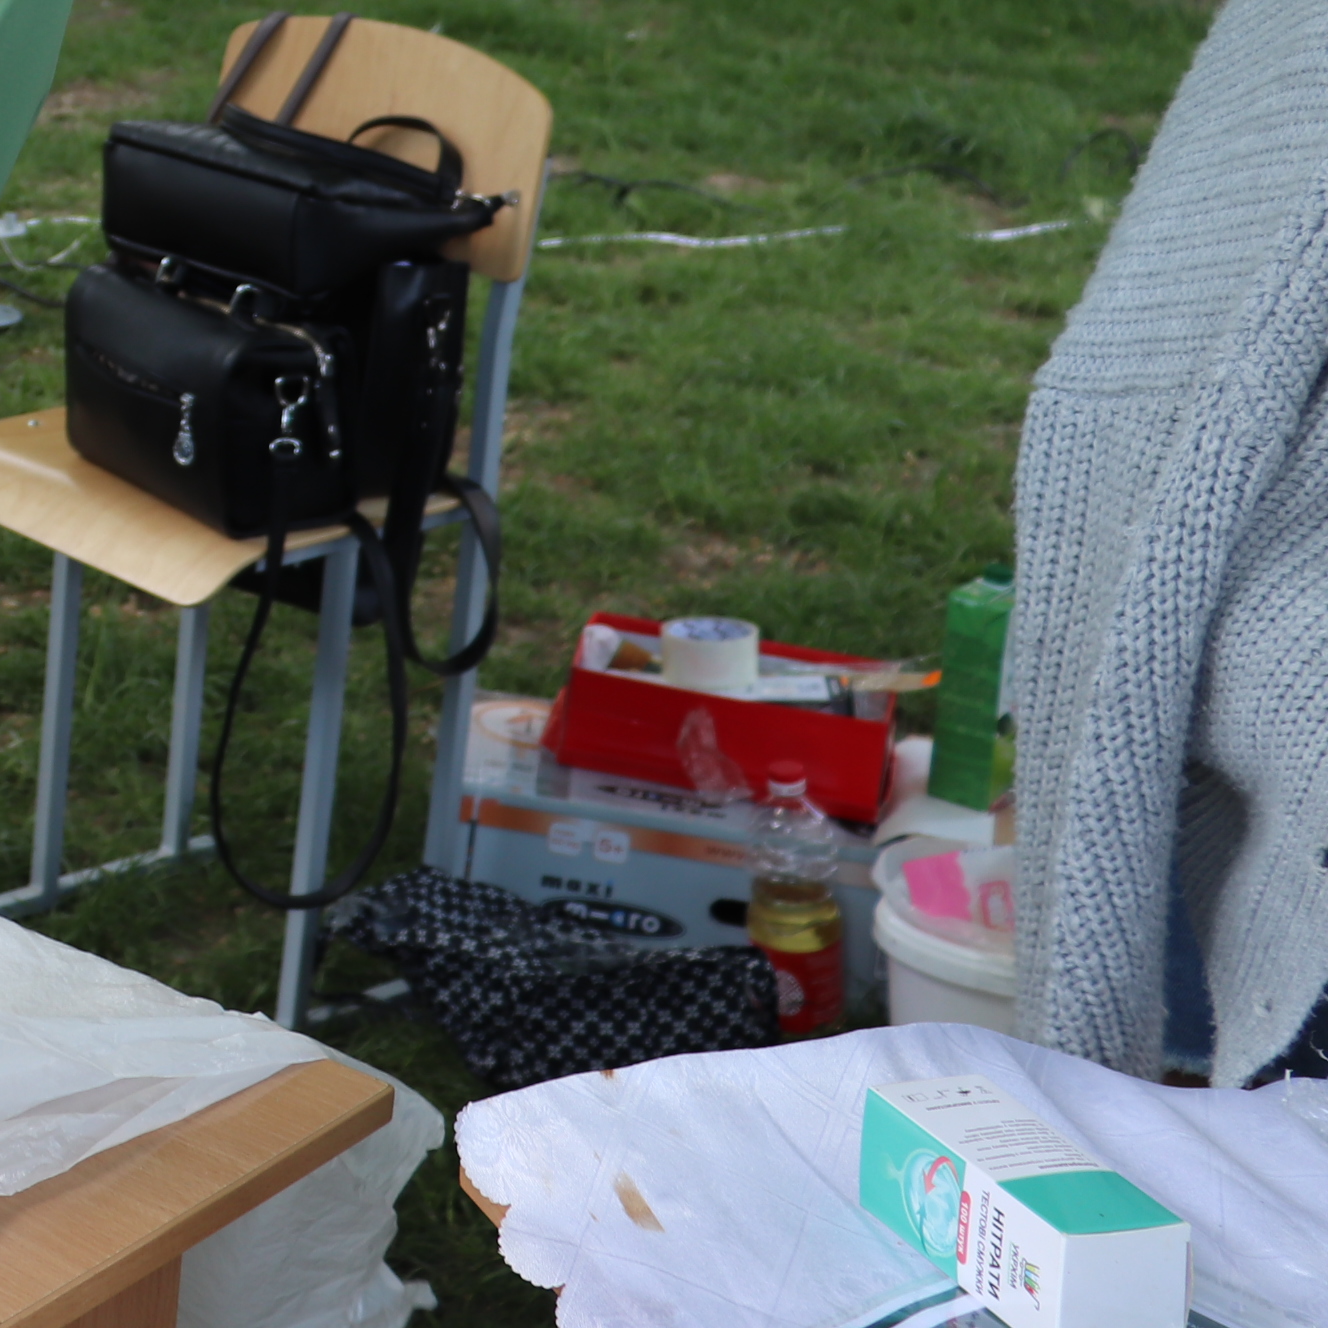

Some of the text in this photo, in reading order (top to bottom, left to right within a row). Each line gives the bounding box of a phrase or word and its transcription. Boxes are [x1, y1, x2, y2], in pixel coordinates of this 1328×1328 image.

[957, 1202, 969, 1255] 100 штук
[975, 1190, 991, 1296] ТЕСТОВІ СМУЖКИ
[987, 1207, 1006, 1302] НІТРАТИ
[1009, 1241, 1020, 1290] УКРХІМ
